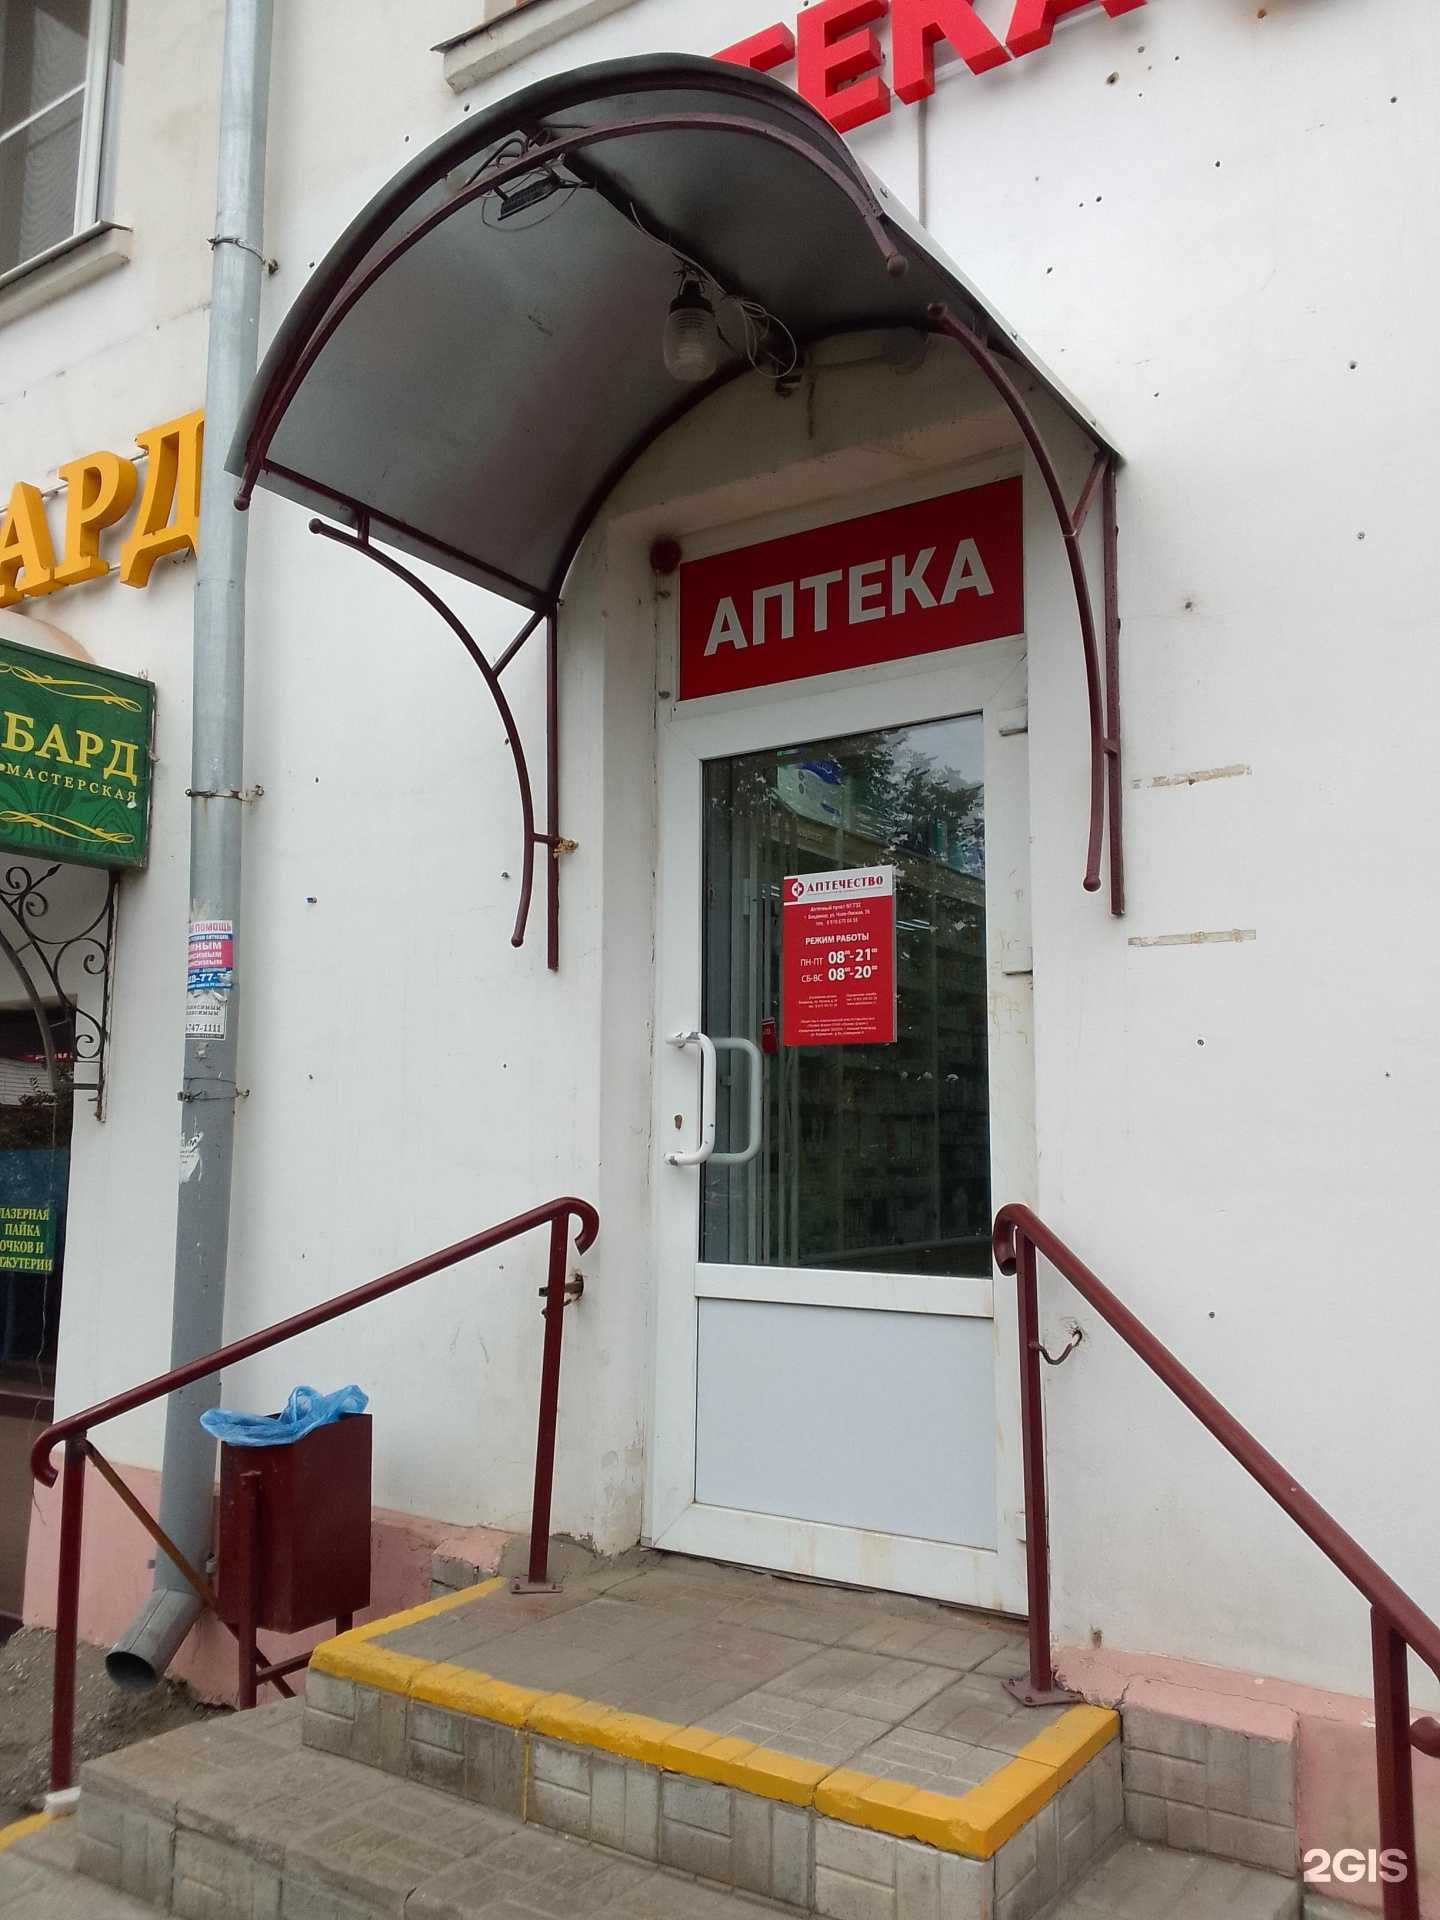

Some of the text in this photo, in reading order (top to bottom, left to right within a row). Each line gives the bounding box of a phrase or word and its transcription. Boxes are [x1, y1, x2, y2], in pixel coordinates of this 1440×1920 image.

[704, 537, 994, 657] АПТЕКА
[1, 711, 139, 786] БАРД
[5, 762, 137, 803] МАСТЕРСКАЯ
[807, 875, 884, 893] АПТЕЧЕСТВО
[805, 932, 870, 945] РЕЖИМ РАБОТЫ
[800, 957, 824, 967] ПН-ПТ
[801, 974, 824, 983] СБ-ВС
[5, 1221, 41, 1237] ПАЙКА
[0, 1239, 44, 1255] ОЧКОВ И
